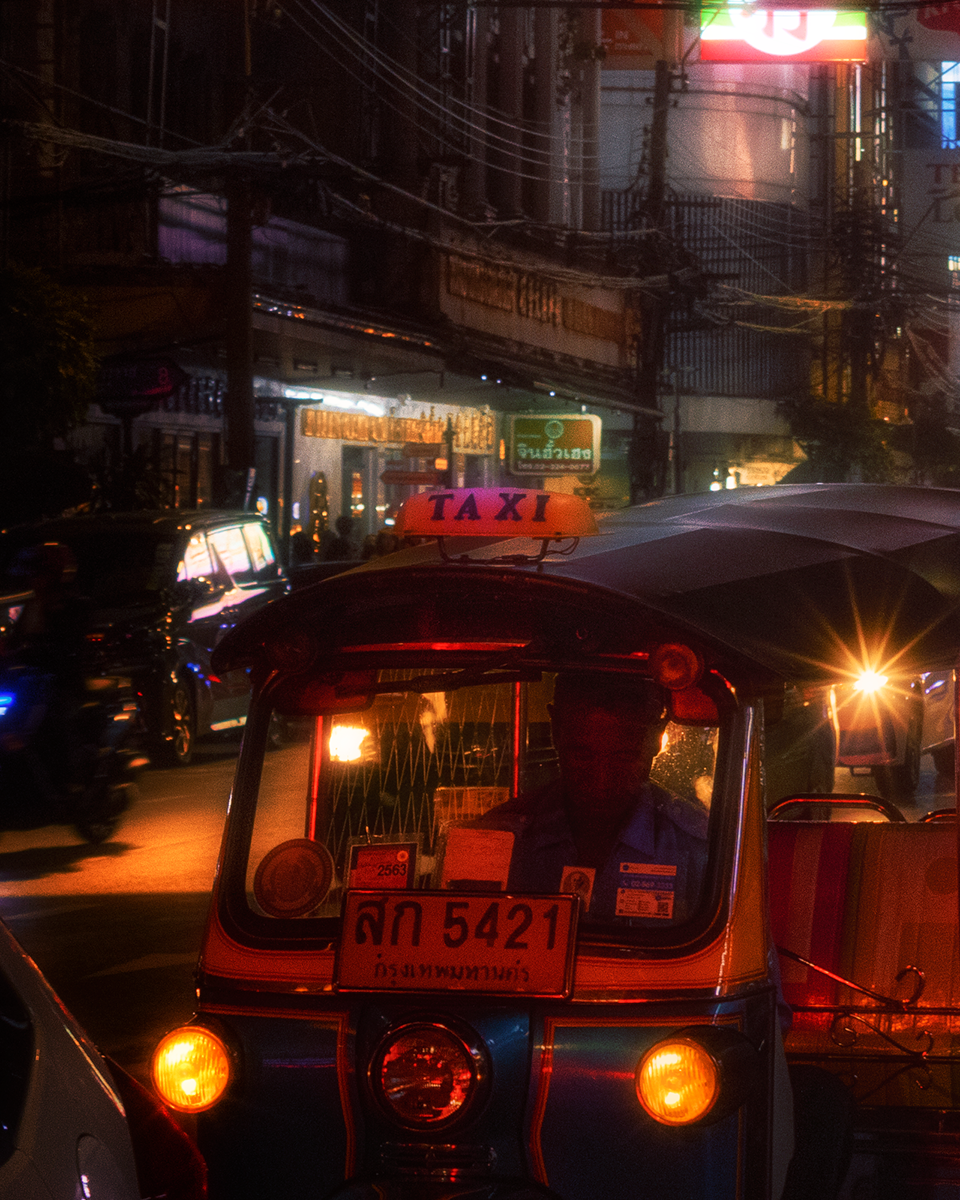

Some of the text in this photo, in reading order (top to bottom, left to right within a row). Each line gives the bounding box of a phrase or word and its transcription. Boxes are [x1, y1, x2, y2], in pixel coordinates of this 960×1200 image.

[428, 492, 551, 522] TAXI
[377, 863, 407, 877] 2563
[355, 896, 423, 947] สก
[442, 901, 560, 951] 5421
